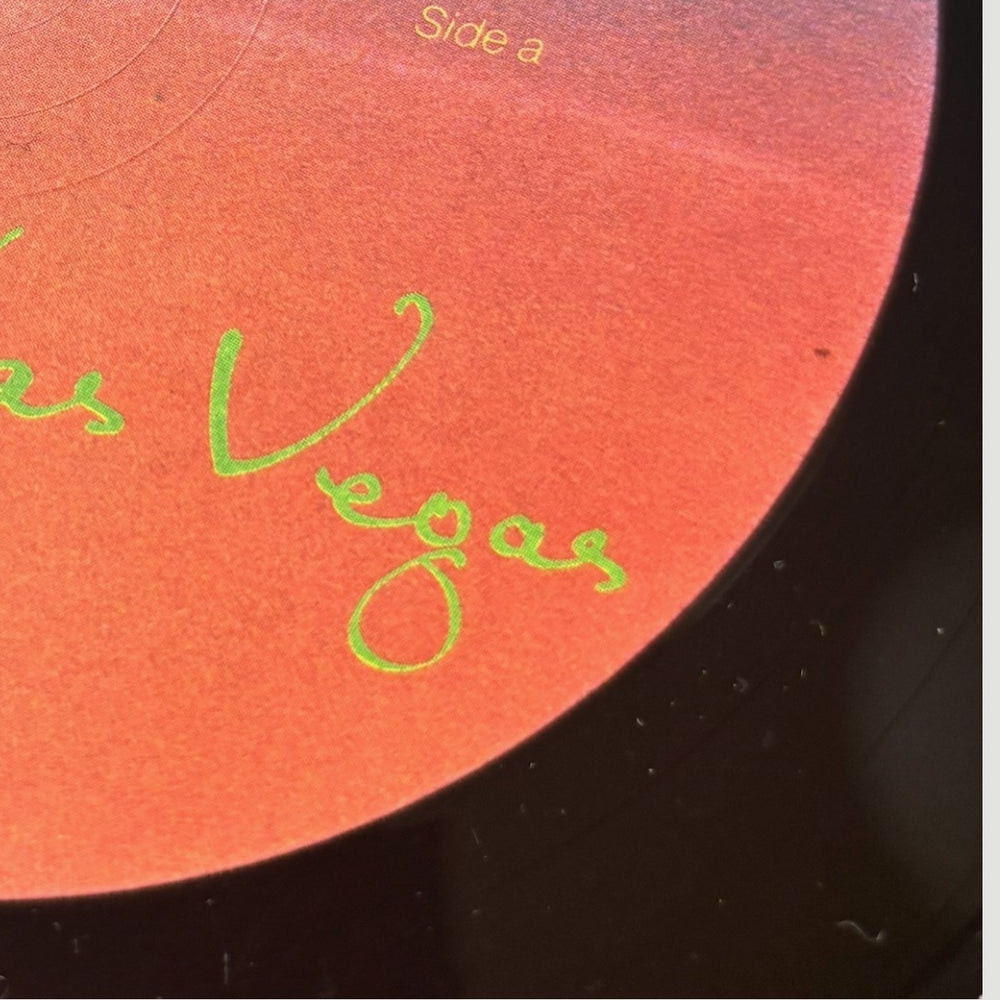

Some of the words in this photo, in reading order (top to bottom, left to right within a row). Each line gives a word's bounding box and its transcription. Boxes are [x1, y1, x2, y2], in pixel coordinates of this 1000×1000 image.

[414, 4, 508, 55] Side
[517, 37, 545, 65] a
[208, 292, 628, 673] Vegas
